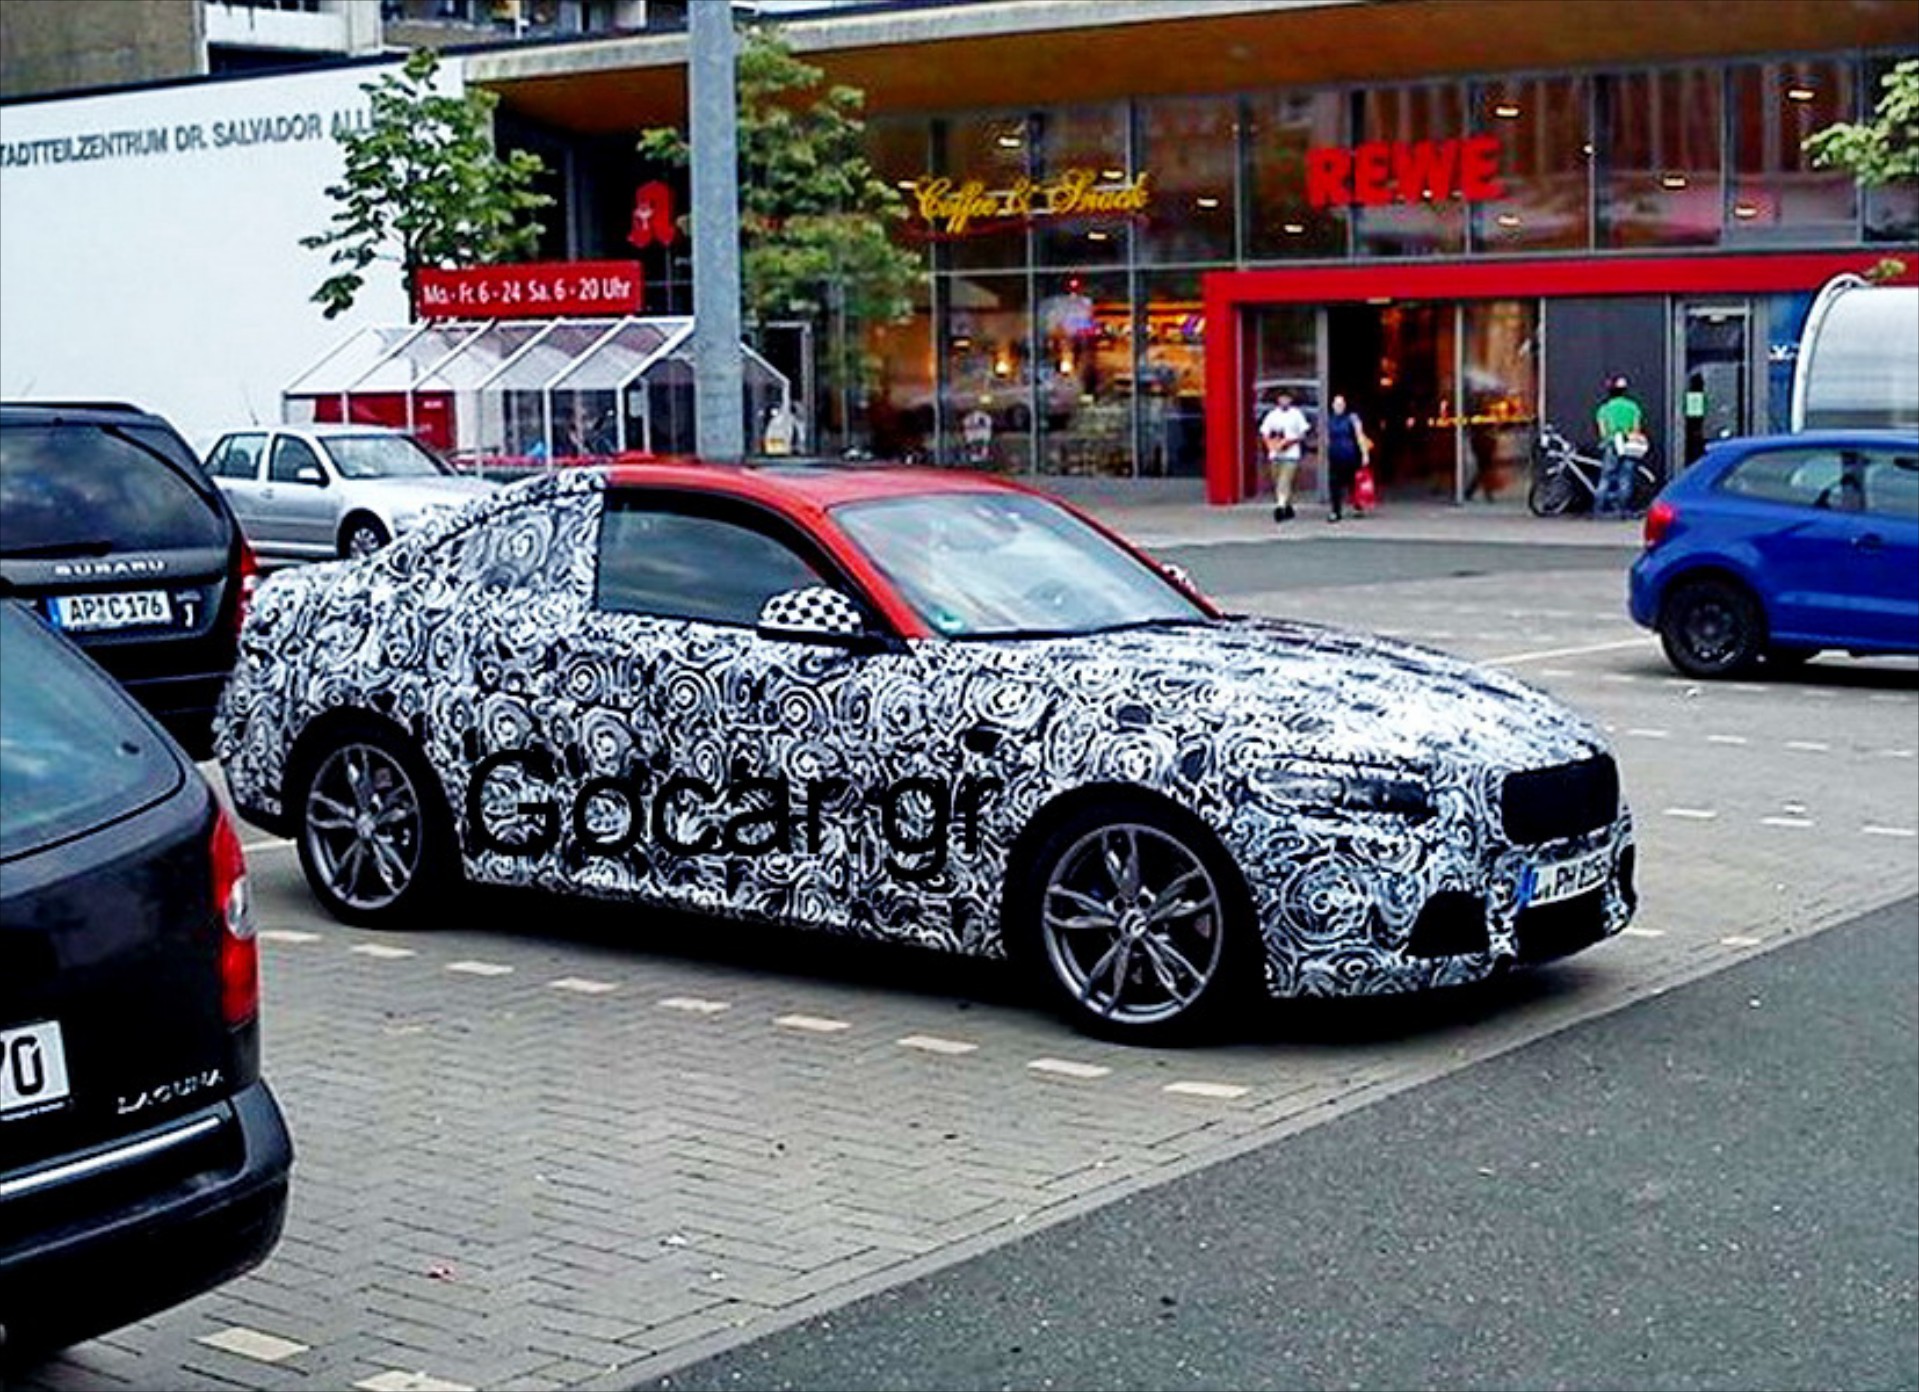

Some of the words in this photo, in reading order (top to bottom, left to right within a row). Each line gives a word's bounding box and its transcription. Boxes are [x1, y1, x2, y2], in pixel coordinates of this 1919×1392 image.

[175, 124, 207, 150] DR.
[213, 113, 322, 147] SALVADOR
[1305, 135, 1503, 210] REWE
[914, 177, 998, 233] Coffee
[1046, 168, 1151, 213] Snack
[502, 280, 521, 303] 24
[579, 277, 599, 300] 20
[603, 275, 632, 299] Uhr
[55, 560, 165, 575] SUBARU
